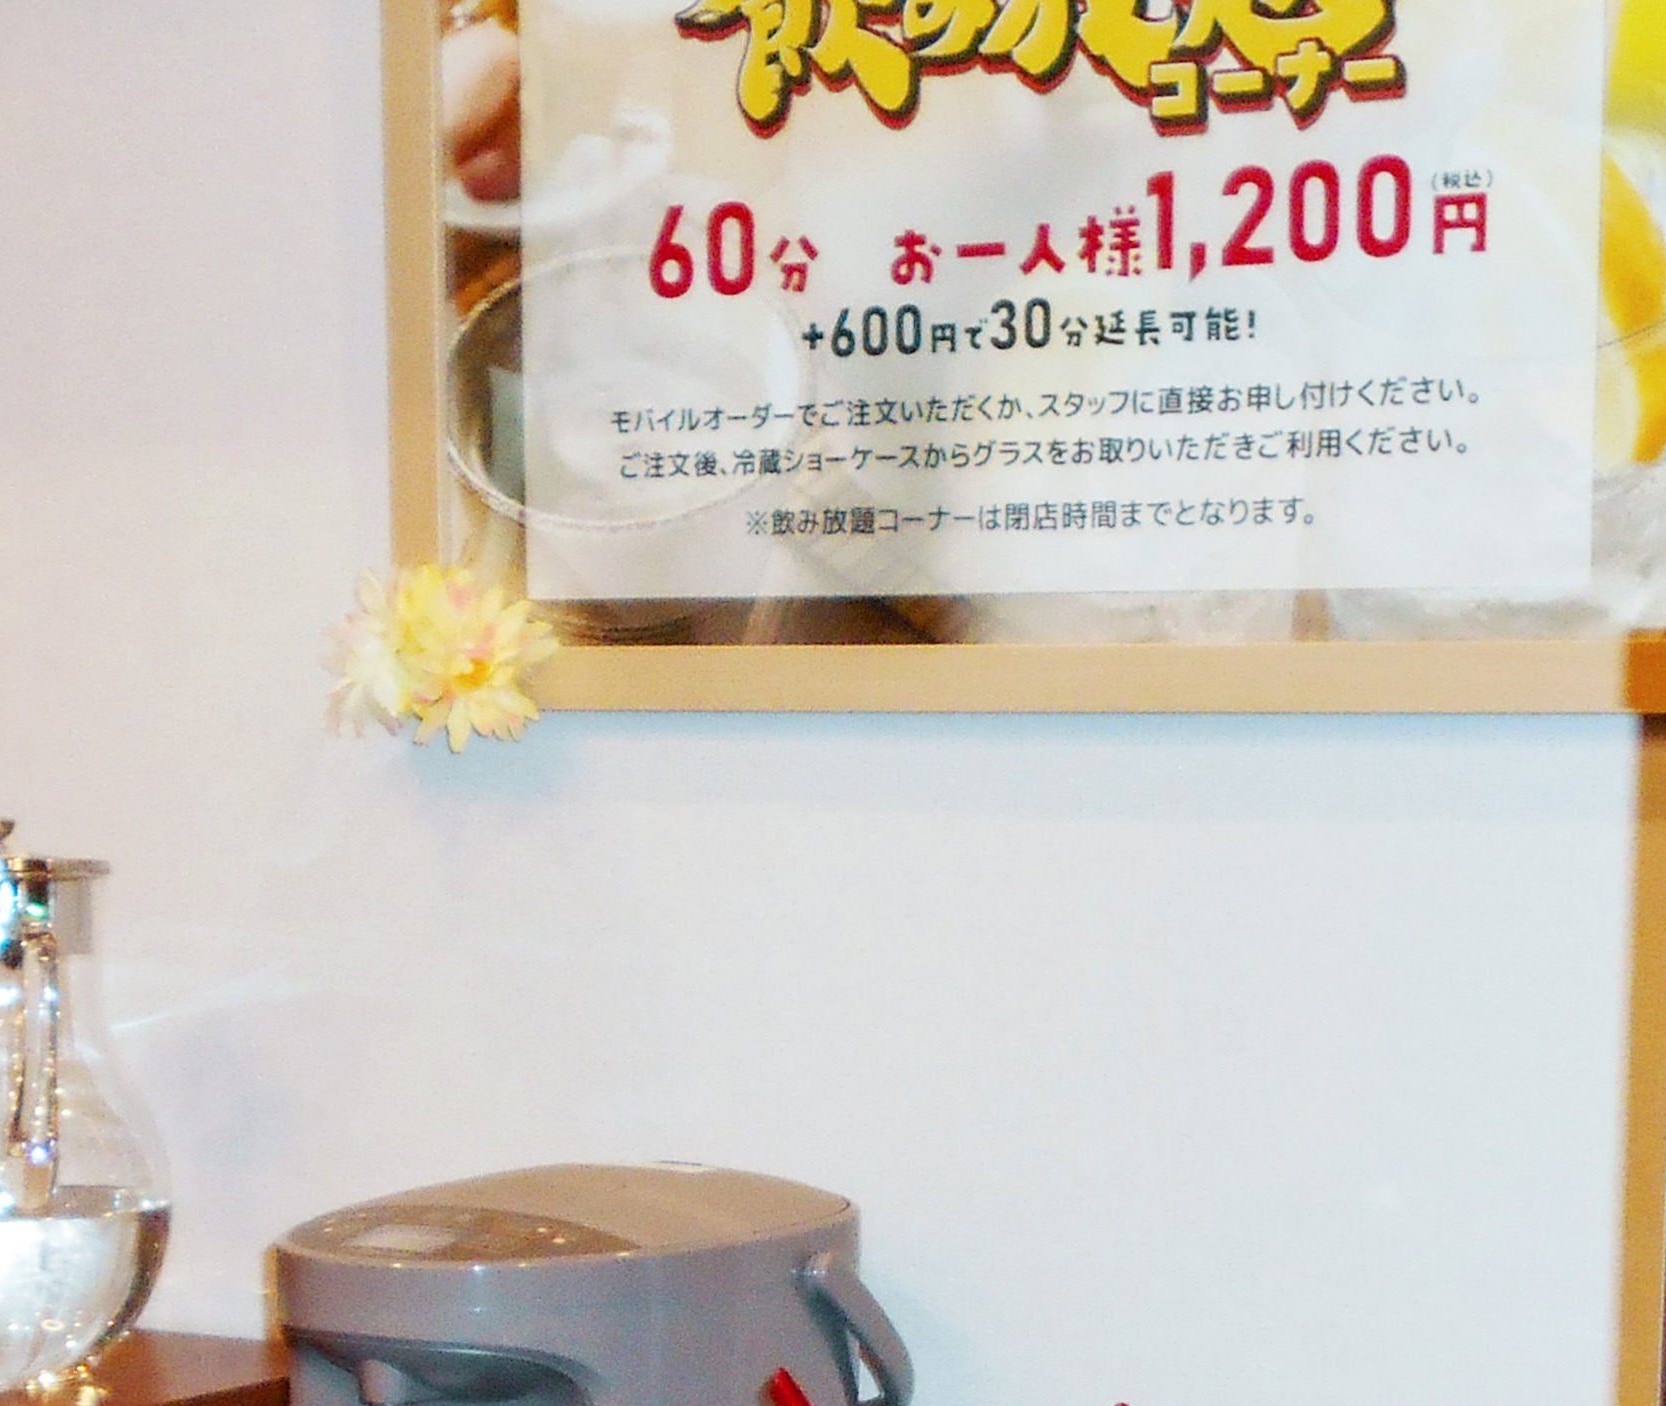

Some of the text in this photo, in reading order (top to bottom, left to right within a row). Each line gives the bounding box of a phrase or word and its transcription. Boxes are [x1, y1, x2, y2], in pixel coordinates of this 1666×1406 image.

[1148, 38, 1408, 137] コーナー
[648, 201, 820, 299] 60分
